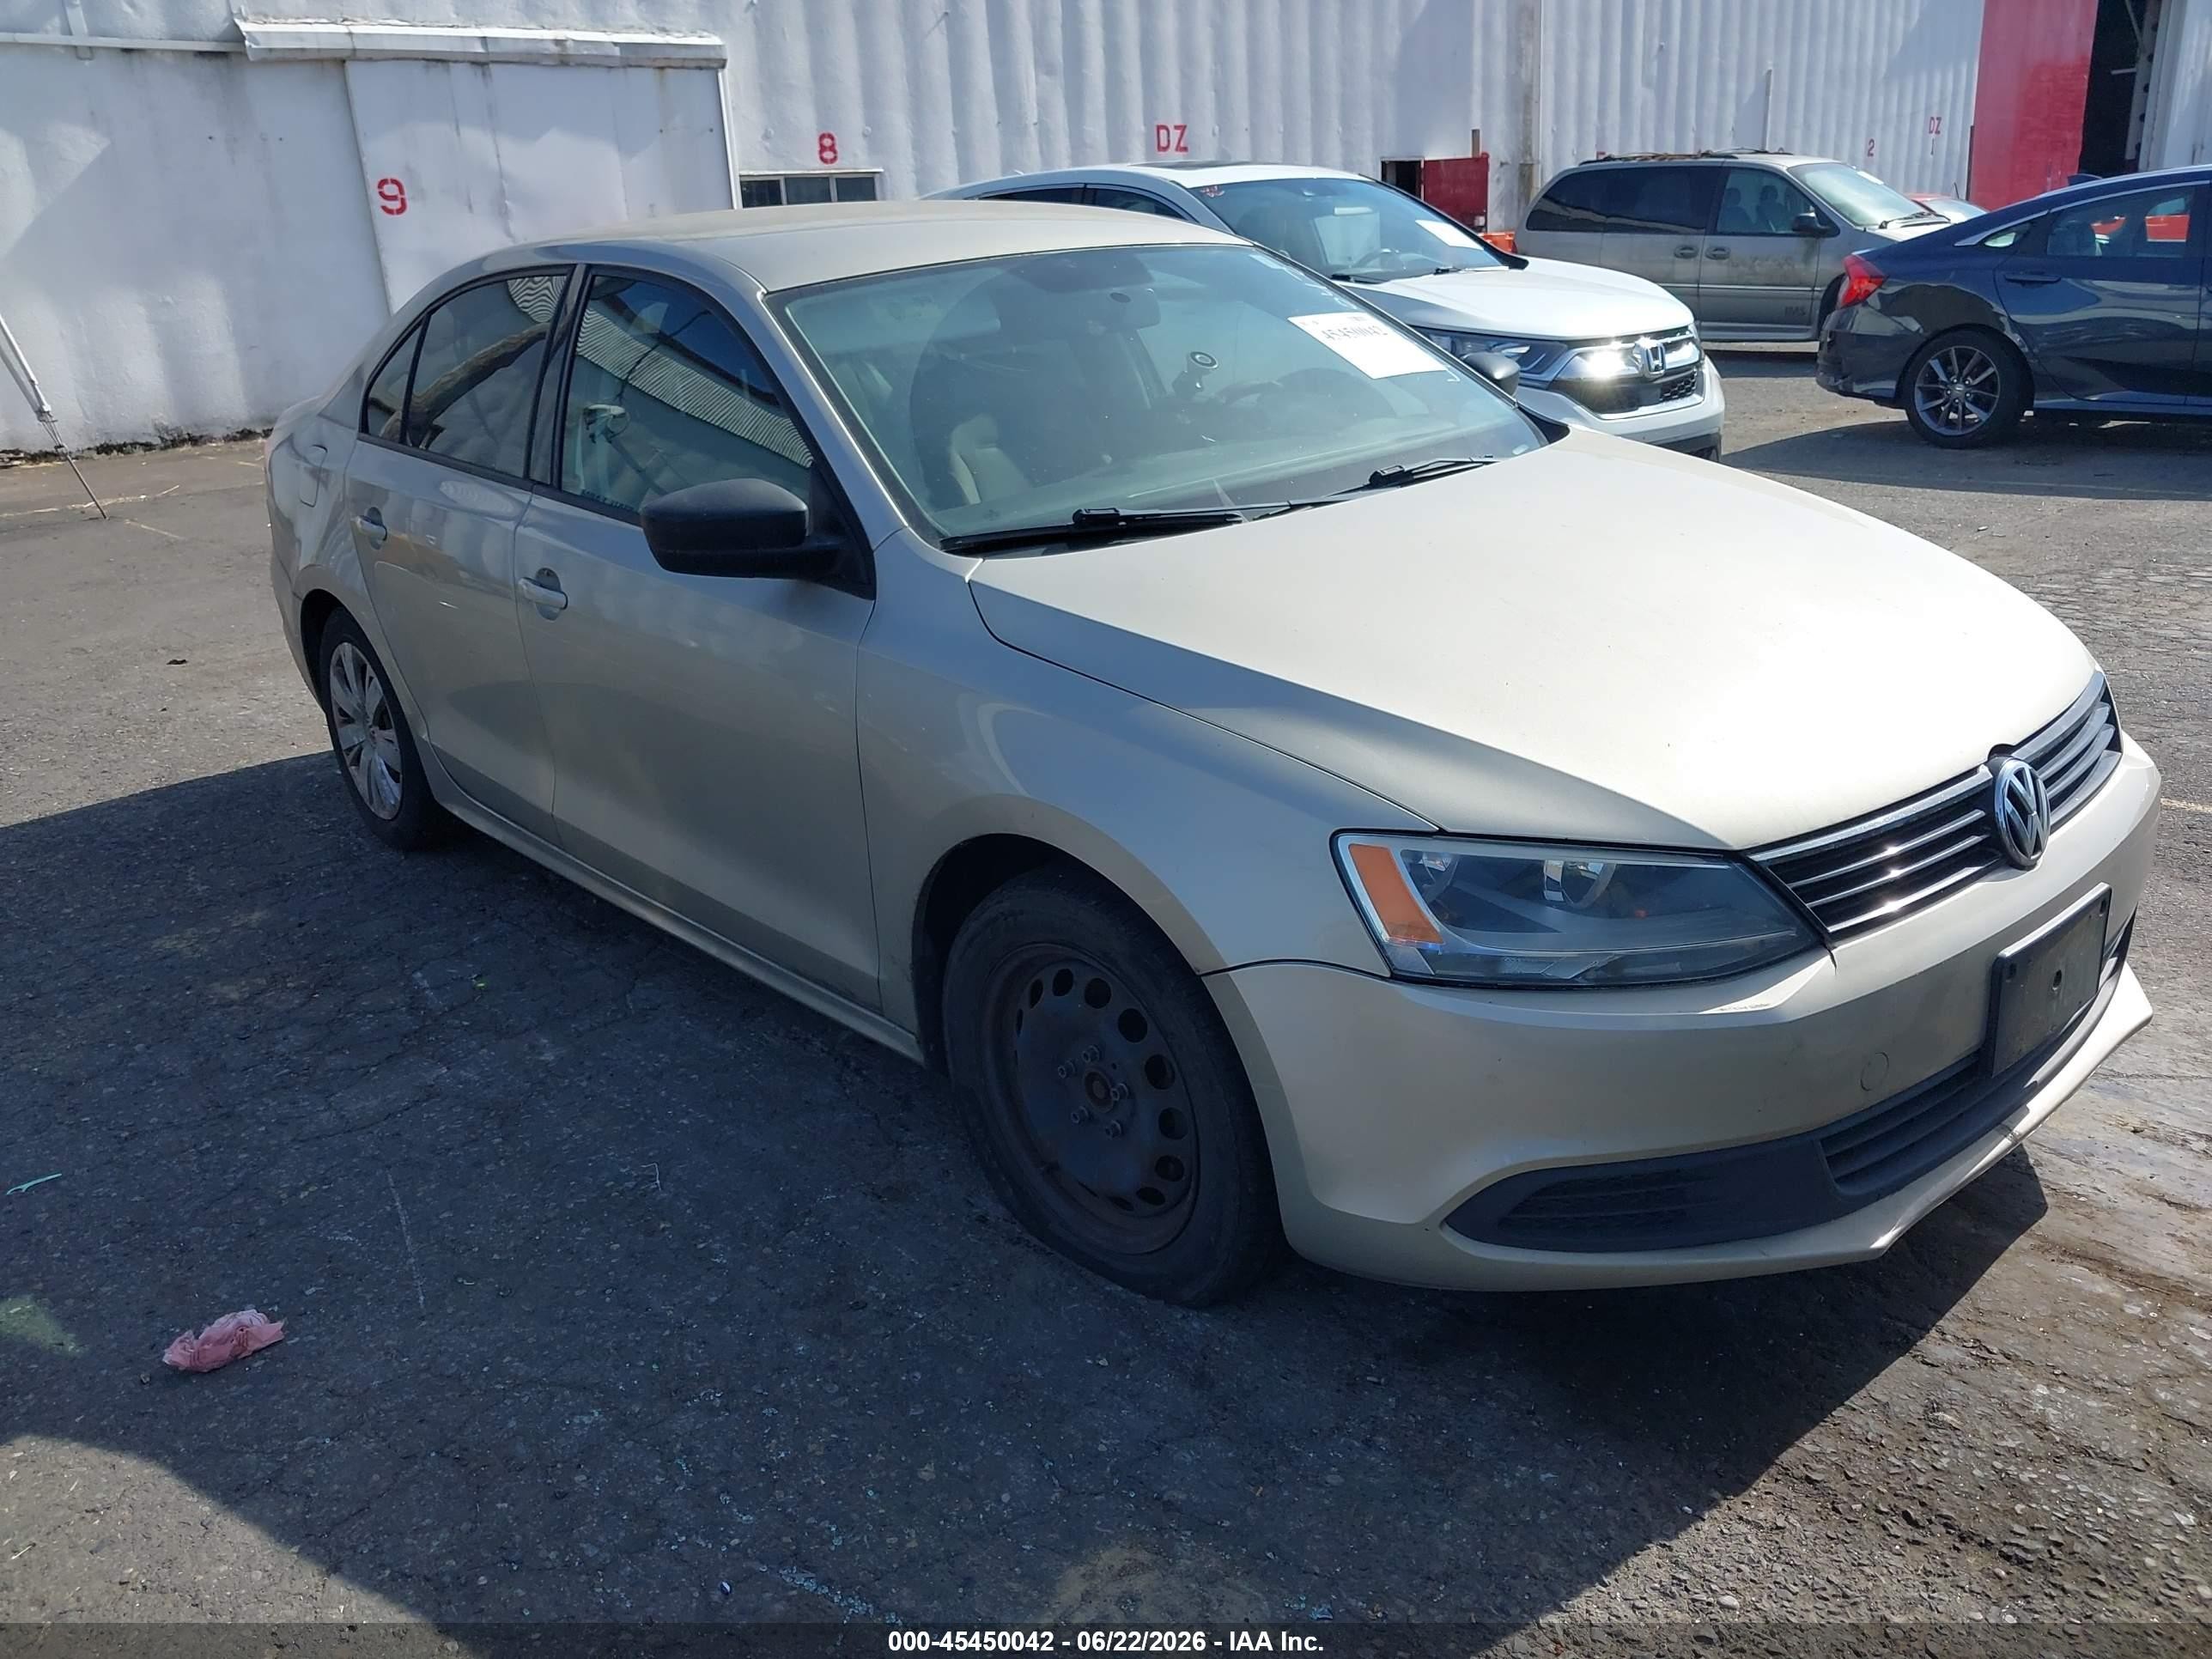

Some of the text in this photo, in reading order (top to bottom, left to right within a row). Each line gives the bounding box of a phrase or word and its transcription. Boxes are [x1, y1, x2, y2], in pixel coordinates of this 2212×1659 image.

[818, 133, 838, 165] 8
[1157, 125, 1188, 153] DZ
[1867, 138, 1875, 157] 2
[378, 178, 408, 216] 9
